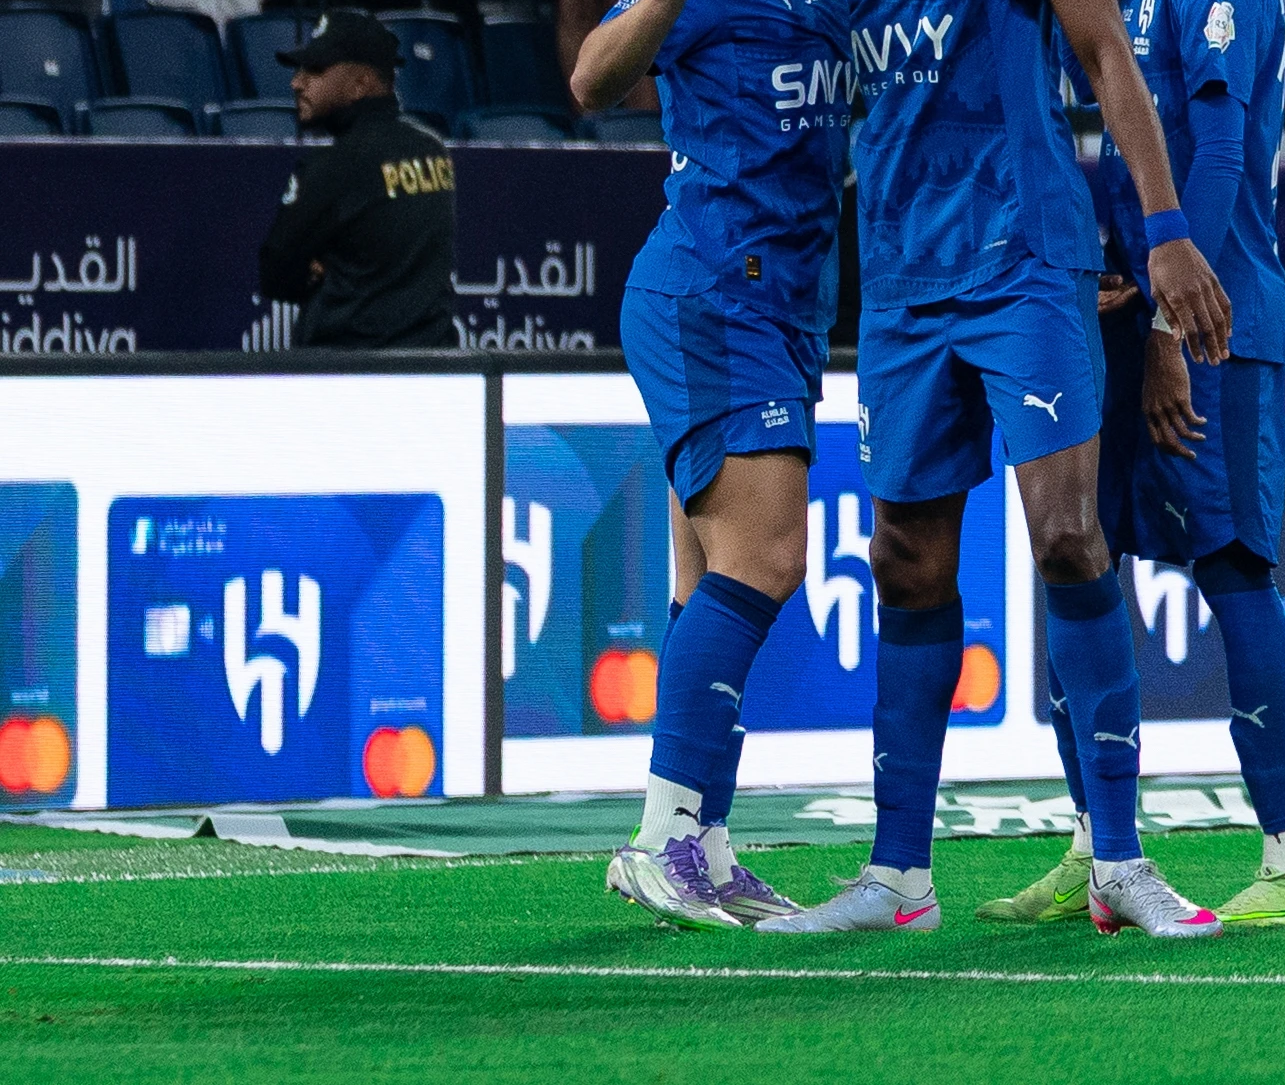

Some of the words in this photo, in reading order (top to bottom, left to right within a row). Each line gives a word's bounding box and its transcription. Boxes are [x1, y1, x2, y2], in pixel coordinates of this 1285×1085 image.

[850, 14, 953, 74] AVVY
[381, 156, 454, 199] POLIC
[0, 312, 137, 354] iddiya
[452, 314, 597, 351] iddiya
